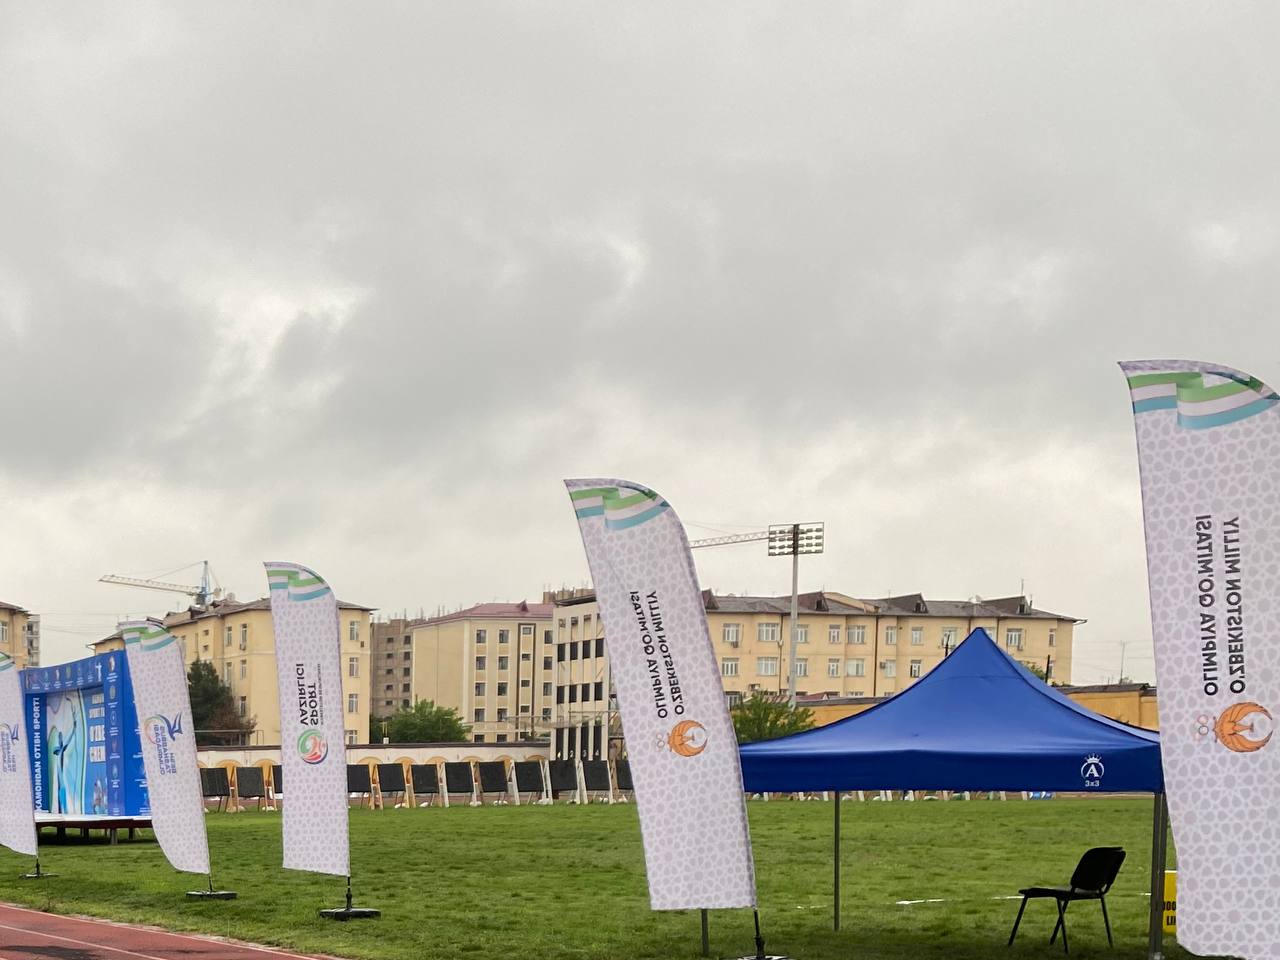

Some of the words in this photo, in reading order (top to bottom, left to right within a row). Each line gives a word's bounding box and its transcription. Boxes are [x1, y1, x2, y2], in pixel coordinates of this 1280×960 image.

[33, 697, 41, 732] SPORTI
[34, 733, 42, 759] OTISH
[1085, 763, 1100, 777] A
